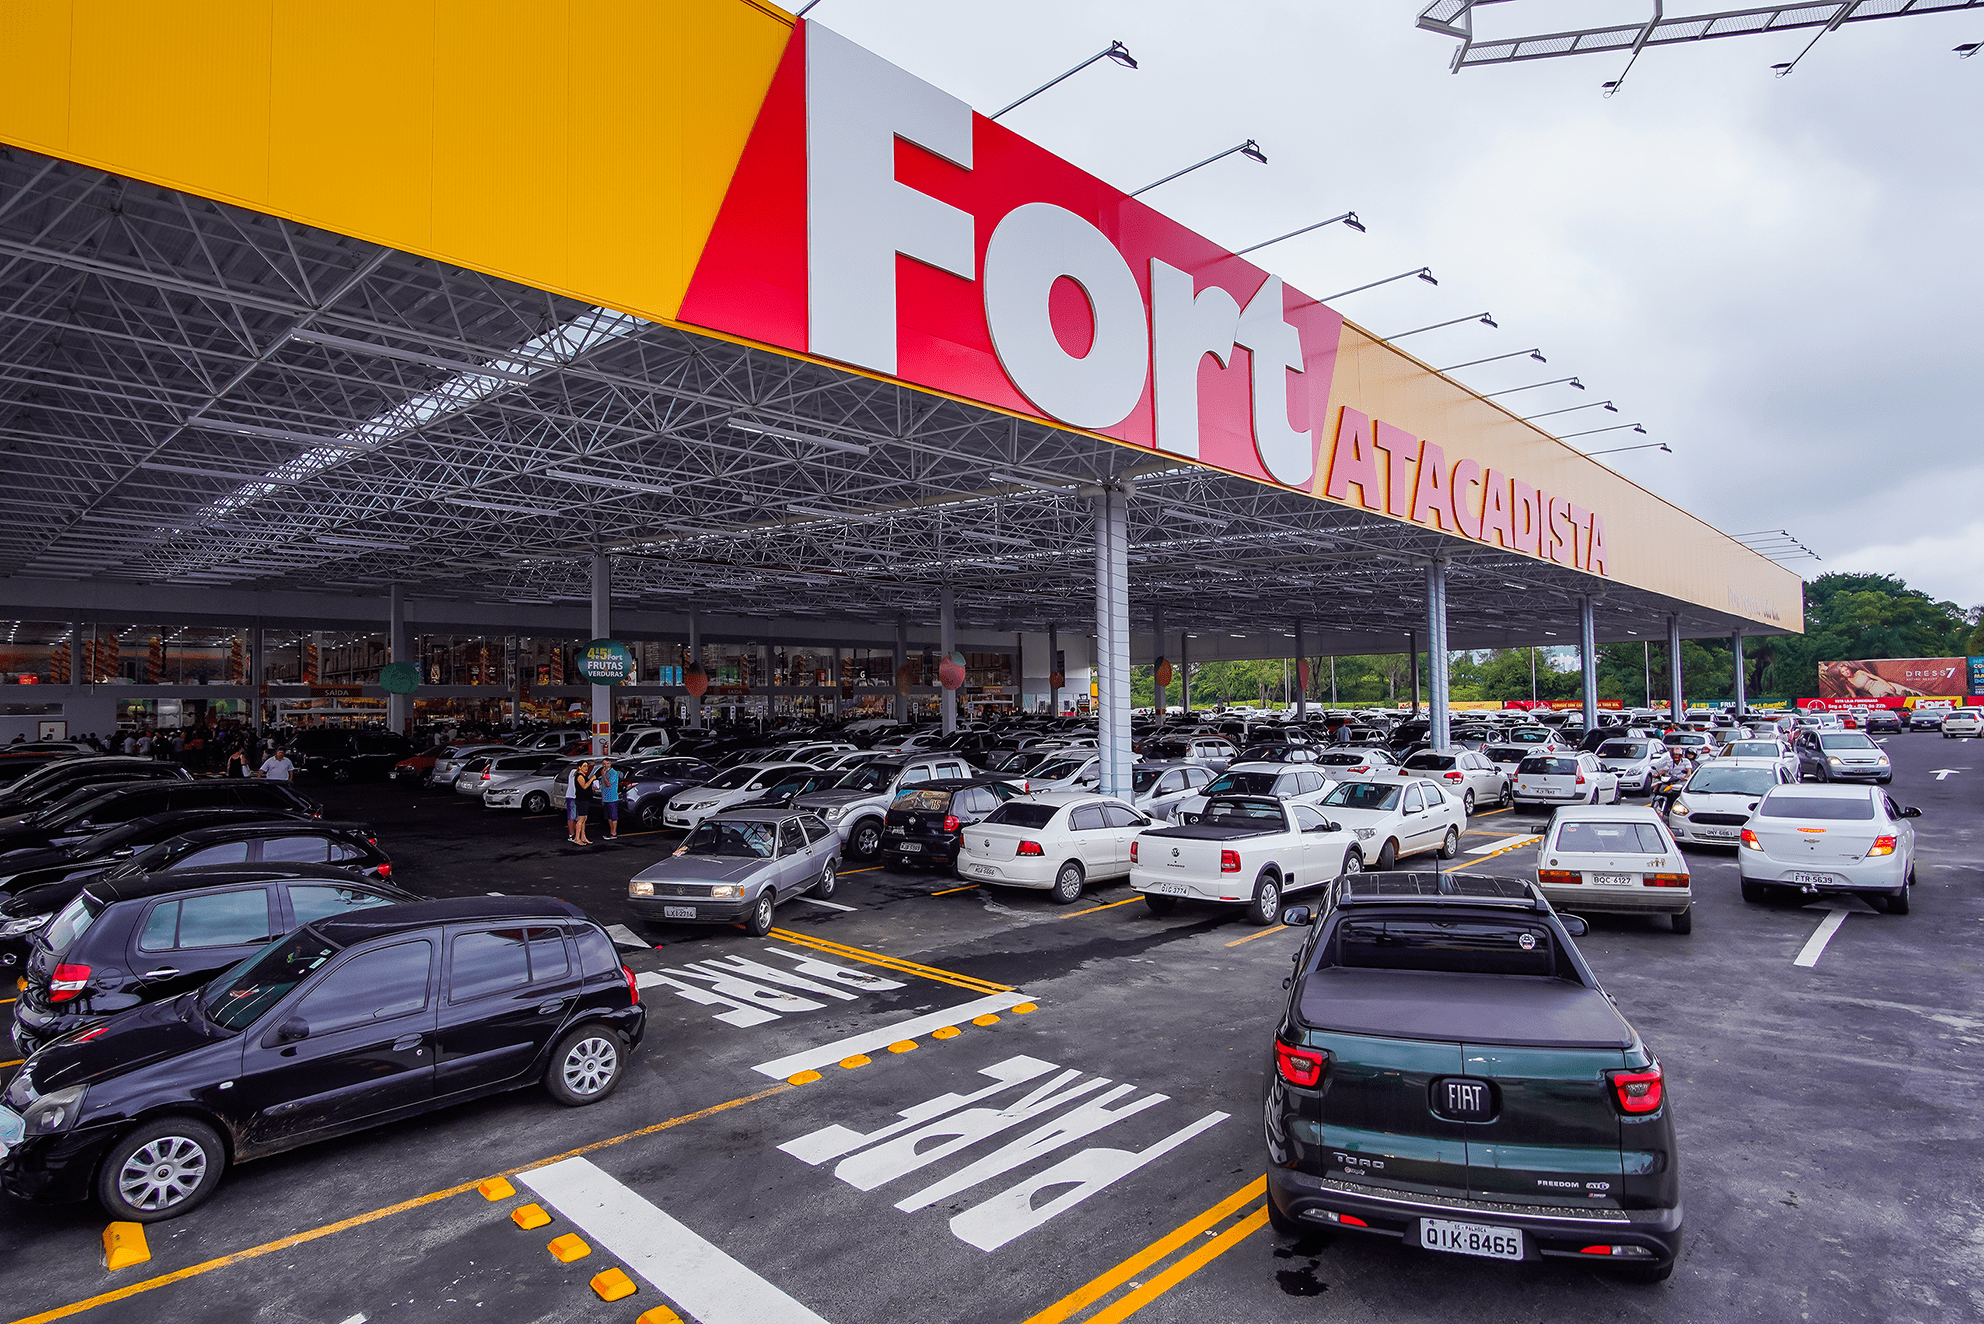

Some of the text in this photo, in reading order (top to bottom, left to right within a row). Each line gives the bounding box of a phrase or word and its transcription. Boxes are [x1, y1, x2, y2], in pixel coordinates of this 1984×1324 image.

[805, 17, 1312, 487] Fort
[1326, 405, 1609, 576] ATACADISTA
[588, 660, 625, 671] FRUTAS
[588, 670, 625, 679] VERDURAS
[1915, 698, 1952, 710] Fort
[637, 946, 908, 1029] PARE
[1448, 1083, 1482, 1111] FIAT
[776, 1054, 1231, 1252] PARE
[1333, 1151, 1385, 1169] TORO
[1537, 1179, 1580, 1188] FREEDOM
